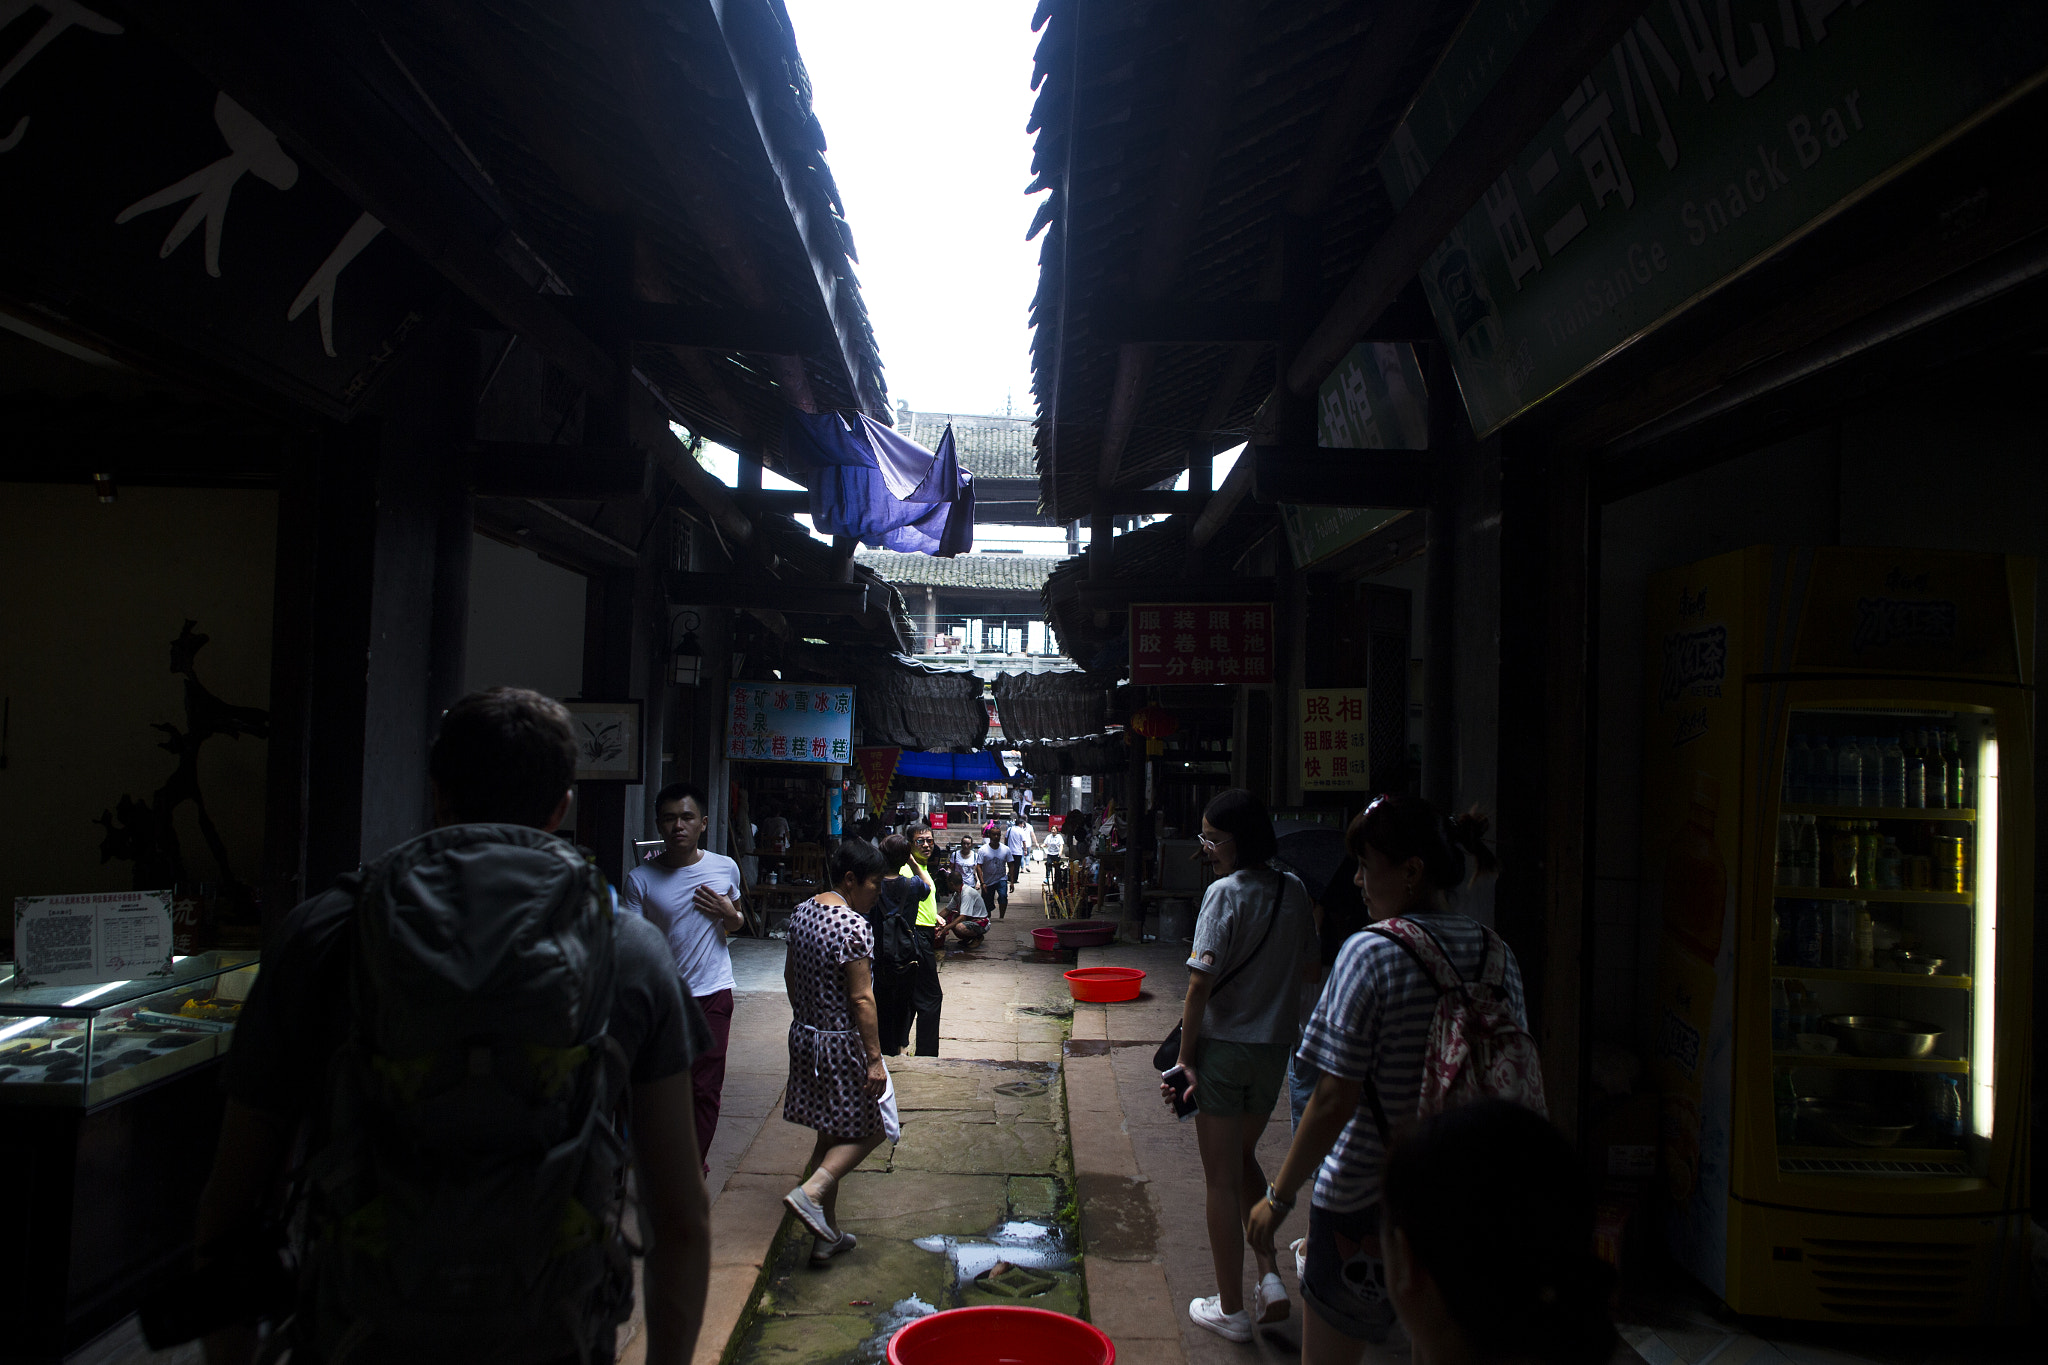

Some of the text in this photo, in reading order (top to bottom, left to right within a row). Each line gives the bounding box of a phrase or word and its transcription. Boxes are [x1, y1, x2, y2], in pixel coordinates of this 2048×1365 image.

[1540, 89, 1865, 347] TianSanGe Snack Bar
[1139, 610, 1265, 630] 服装照相
[1139, 633, 1266, 653] 胶卷电池
[1139, 656, 1265, 676] 一分钟快照
[1304, 696, 1362, 723] 照相
[731, 687, 748, 755] 各类饮料
[751, 689, 769, 755] 矿泉水
[1304, 730, 1347, 751] 租服装
[1305, 757, 1348, 777] 快照
